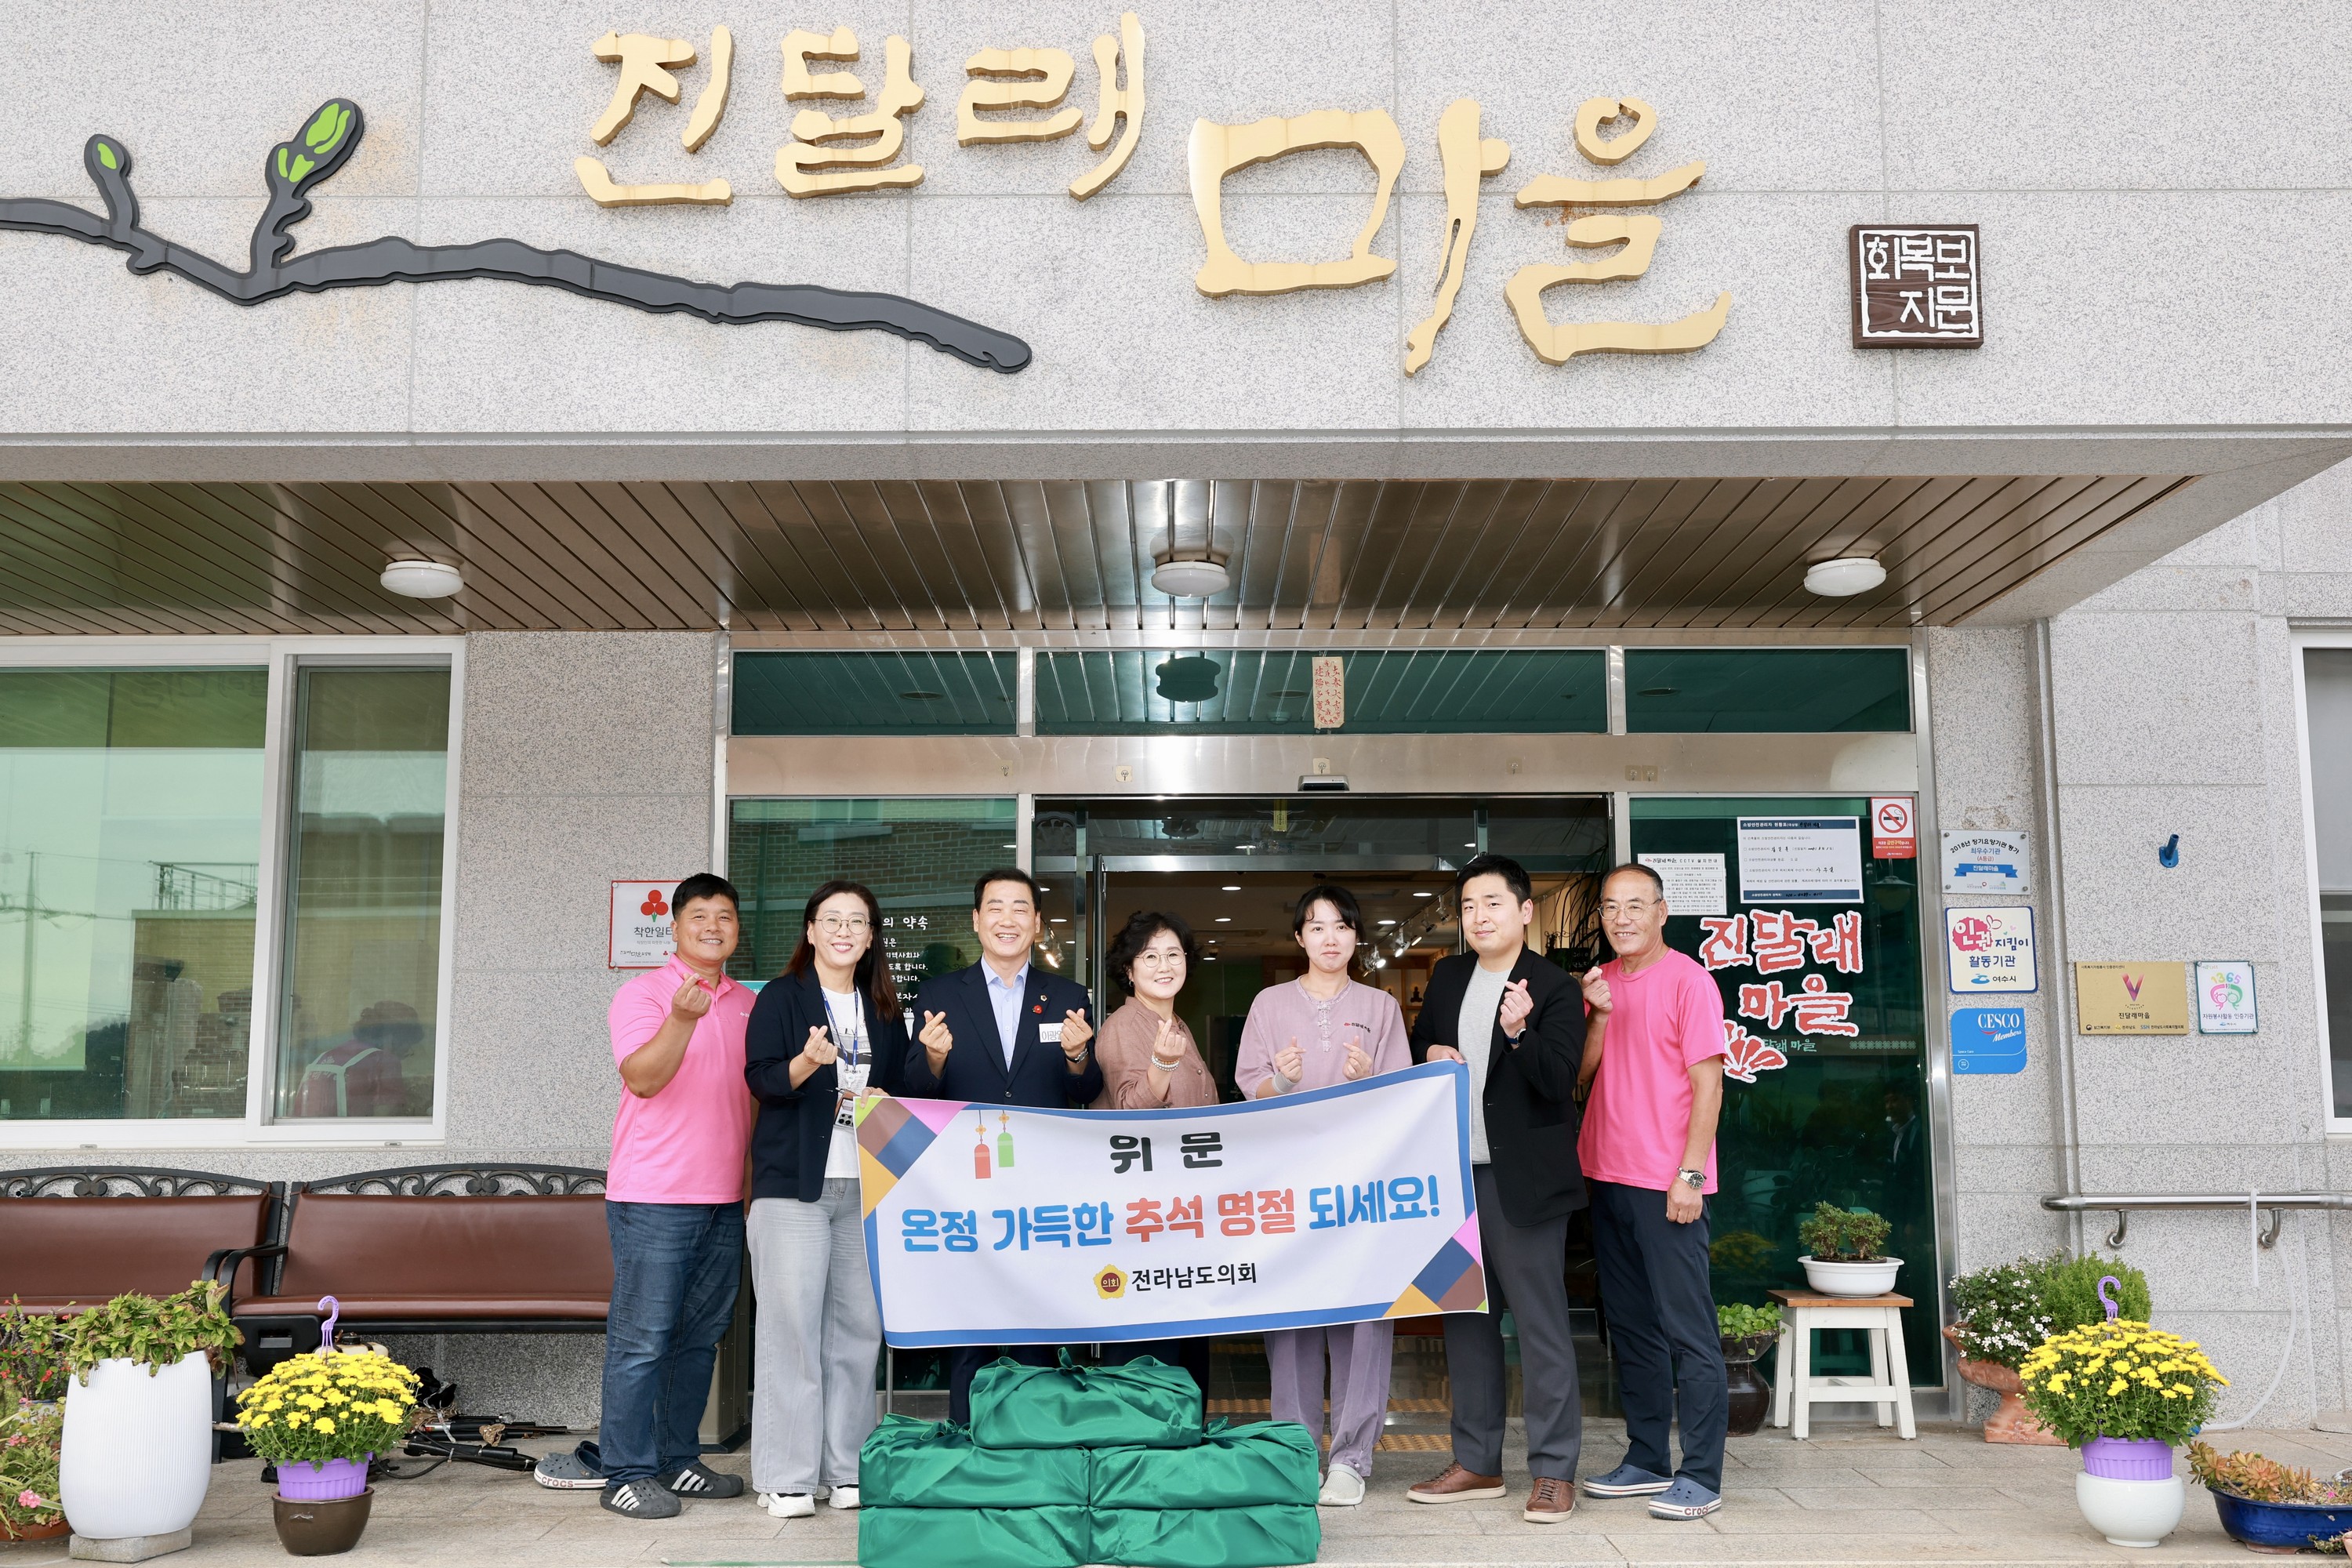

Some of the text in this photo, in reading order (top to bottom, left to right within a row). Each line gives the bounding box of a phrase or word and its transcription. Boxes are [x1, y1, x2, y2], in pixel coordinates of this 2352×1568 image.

[574, 11, 1732, 379] 진달래 마을
[1950, 838, 2020, 855] 2018년 장기요양기관 평가
[902, 916, 928, 931] 약속
[1700, 910, 1862, 973] 진달래
[1955, 919, 2029, 952] 인권 지킴이
[888, 963, 928, 971] 도록 합니다.
[1969, 955, 2016, 968] 활동기관
[2210, 971, 2242, 985] 1365
[1740, 975, 1858, 1035] 마을
[1977, 1013, 2020, 1029] CESCO
[2118, 1011, 2151, 1020] 진달래마을
[1992, 1029, 2022, 1043] Members
[1790, 1038, 1817, 1052] 마을
[901, 1174, 1441, 1254] 온정 가득한 추석 명절 되세요!
[1102, 1277, 1120, 1288] 의회
[1131, 1262, 1257, 1292] 전라남도의회
[541, 1477, 574, 1488] crocs
[1683, 1505, 1709, 1516] crocs
